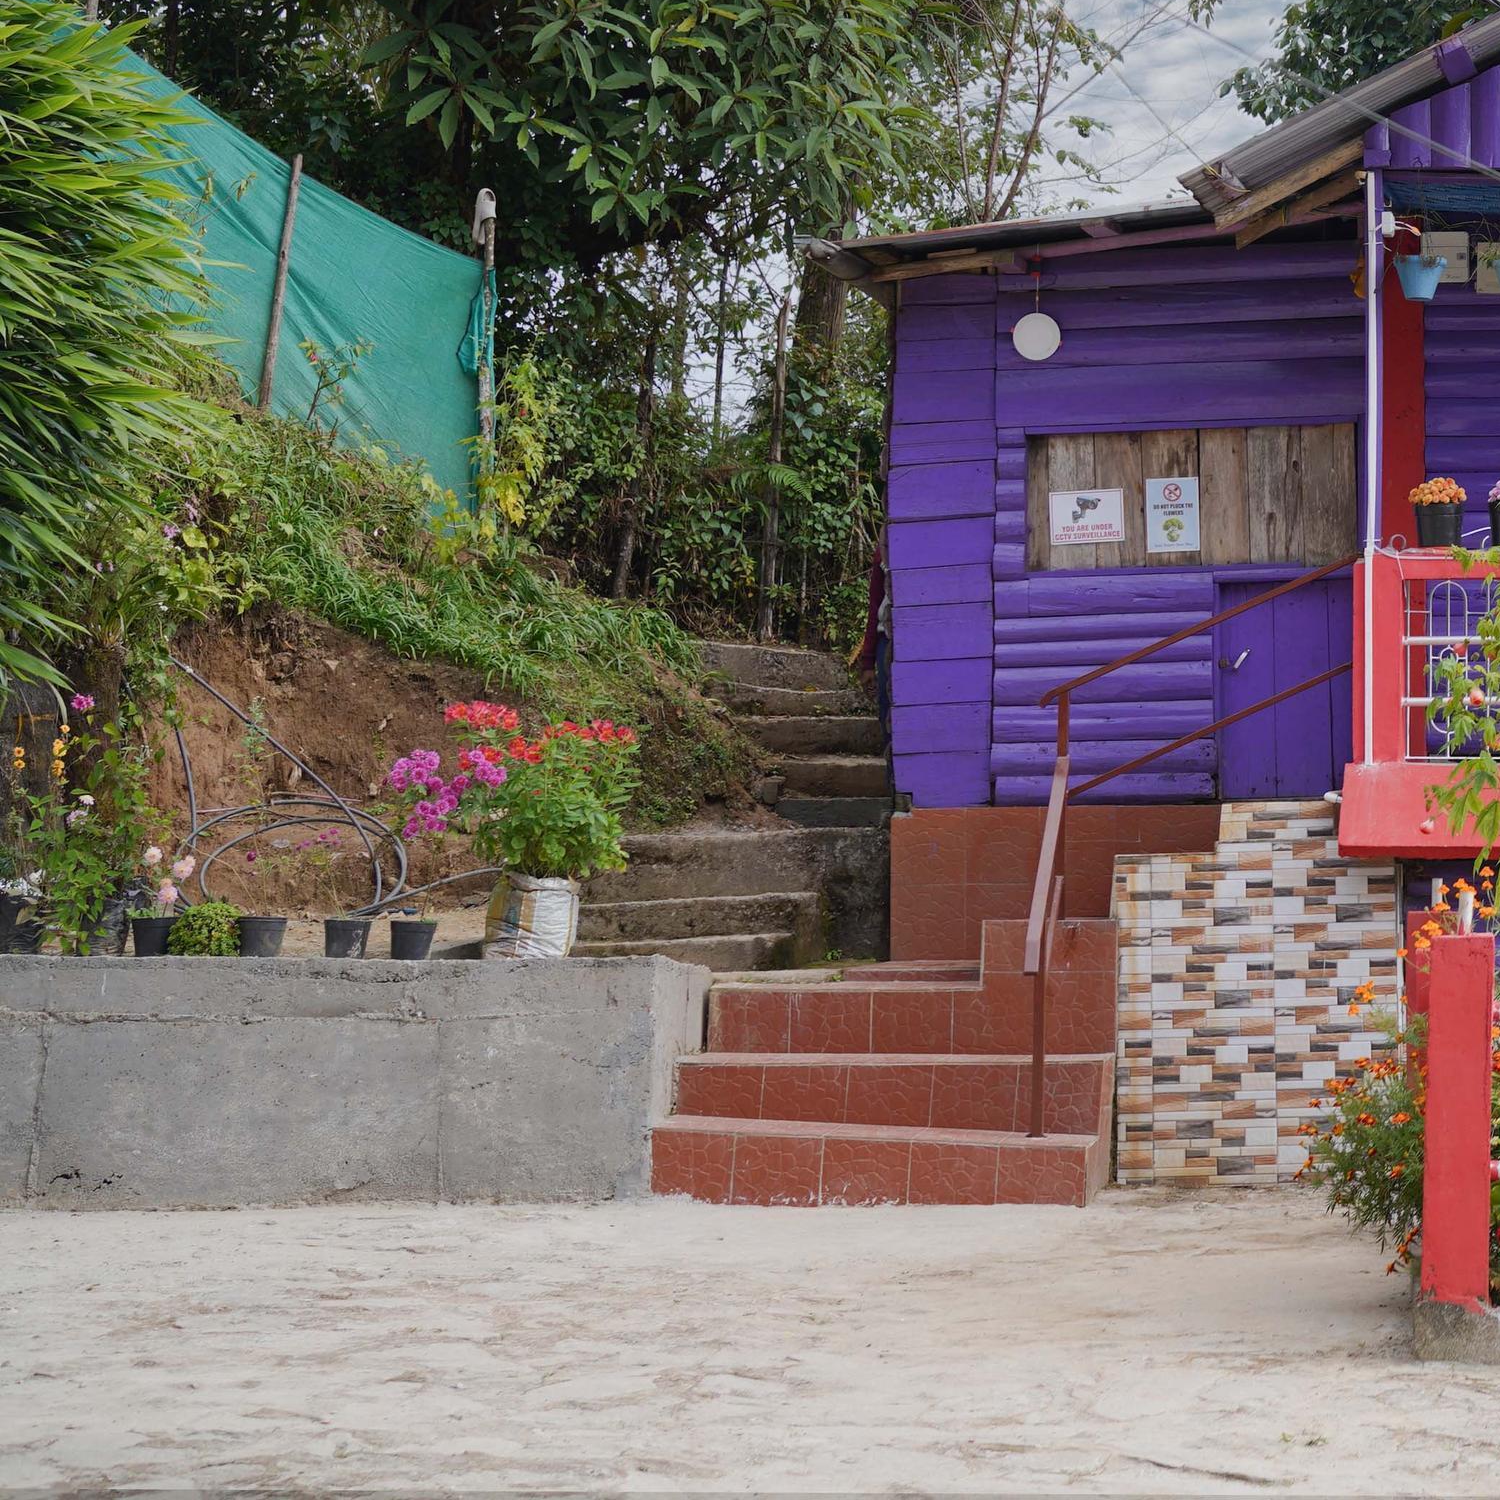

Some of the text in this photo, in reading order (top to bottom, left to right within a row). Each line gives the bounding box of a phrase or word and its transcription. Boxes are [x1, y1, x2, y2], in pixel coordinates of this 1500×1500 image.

[1062, 525, 1075, 533] YOU
[1055, 530, 1121, 541] CCTV SURVEILLANCE
